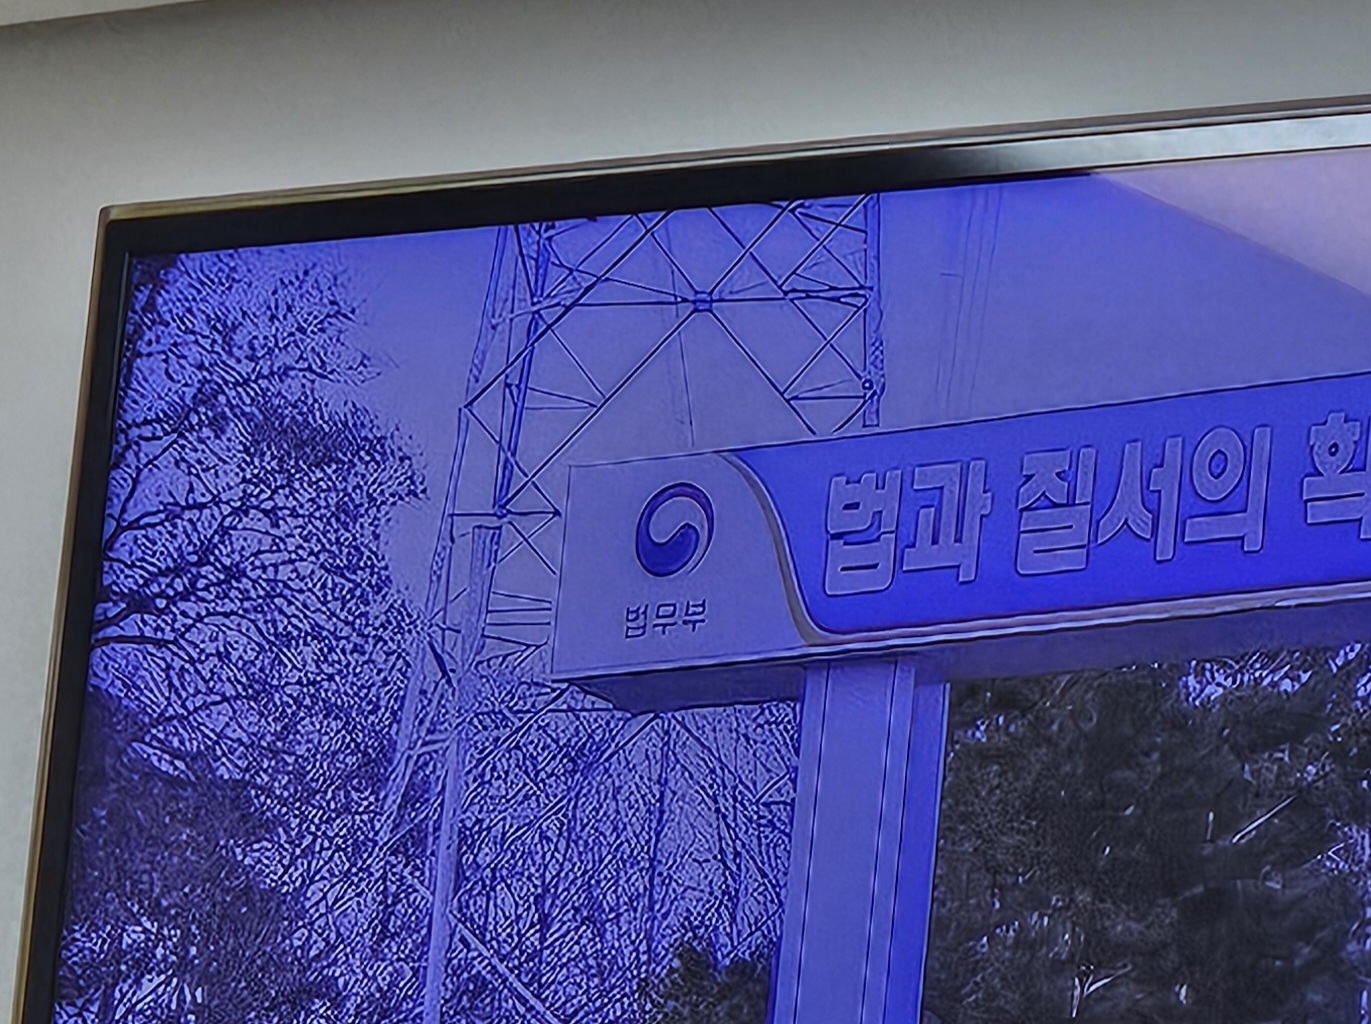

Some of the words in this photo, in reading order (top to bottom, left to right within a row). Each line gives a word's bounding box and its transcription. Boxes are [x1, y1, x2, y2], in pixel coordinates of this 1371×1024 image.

[823, 459, 993, 596] 법과
[1014, 424, 1273, 577] 질서의
[624, 597, 707, 640] 법무부
